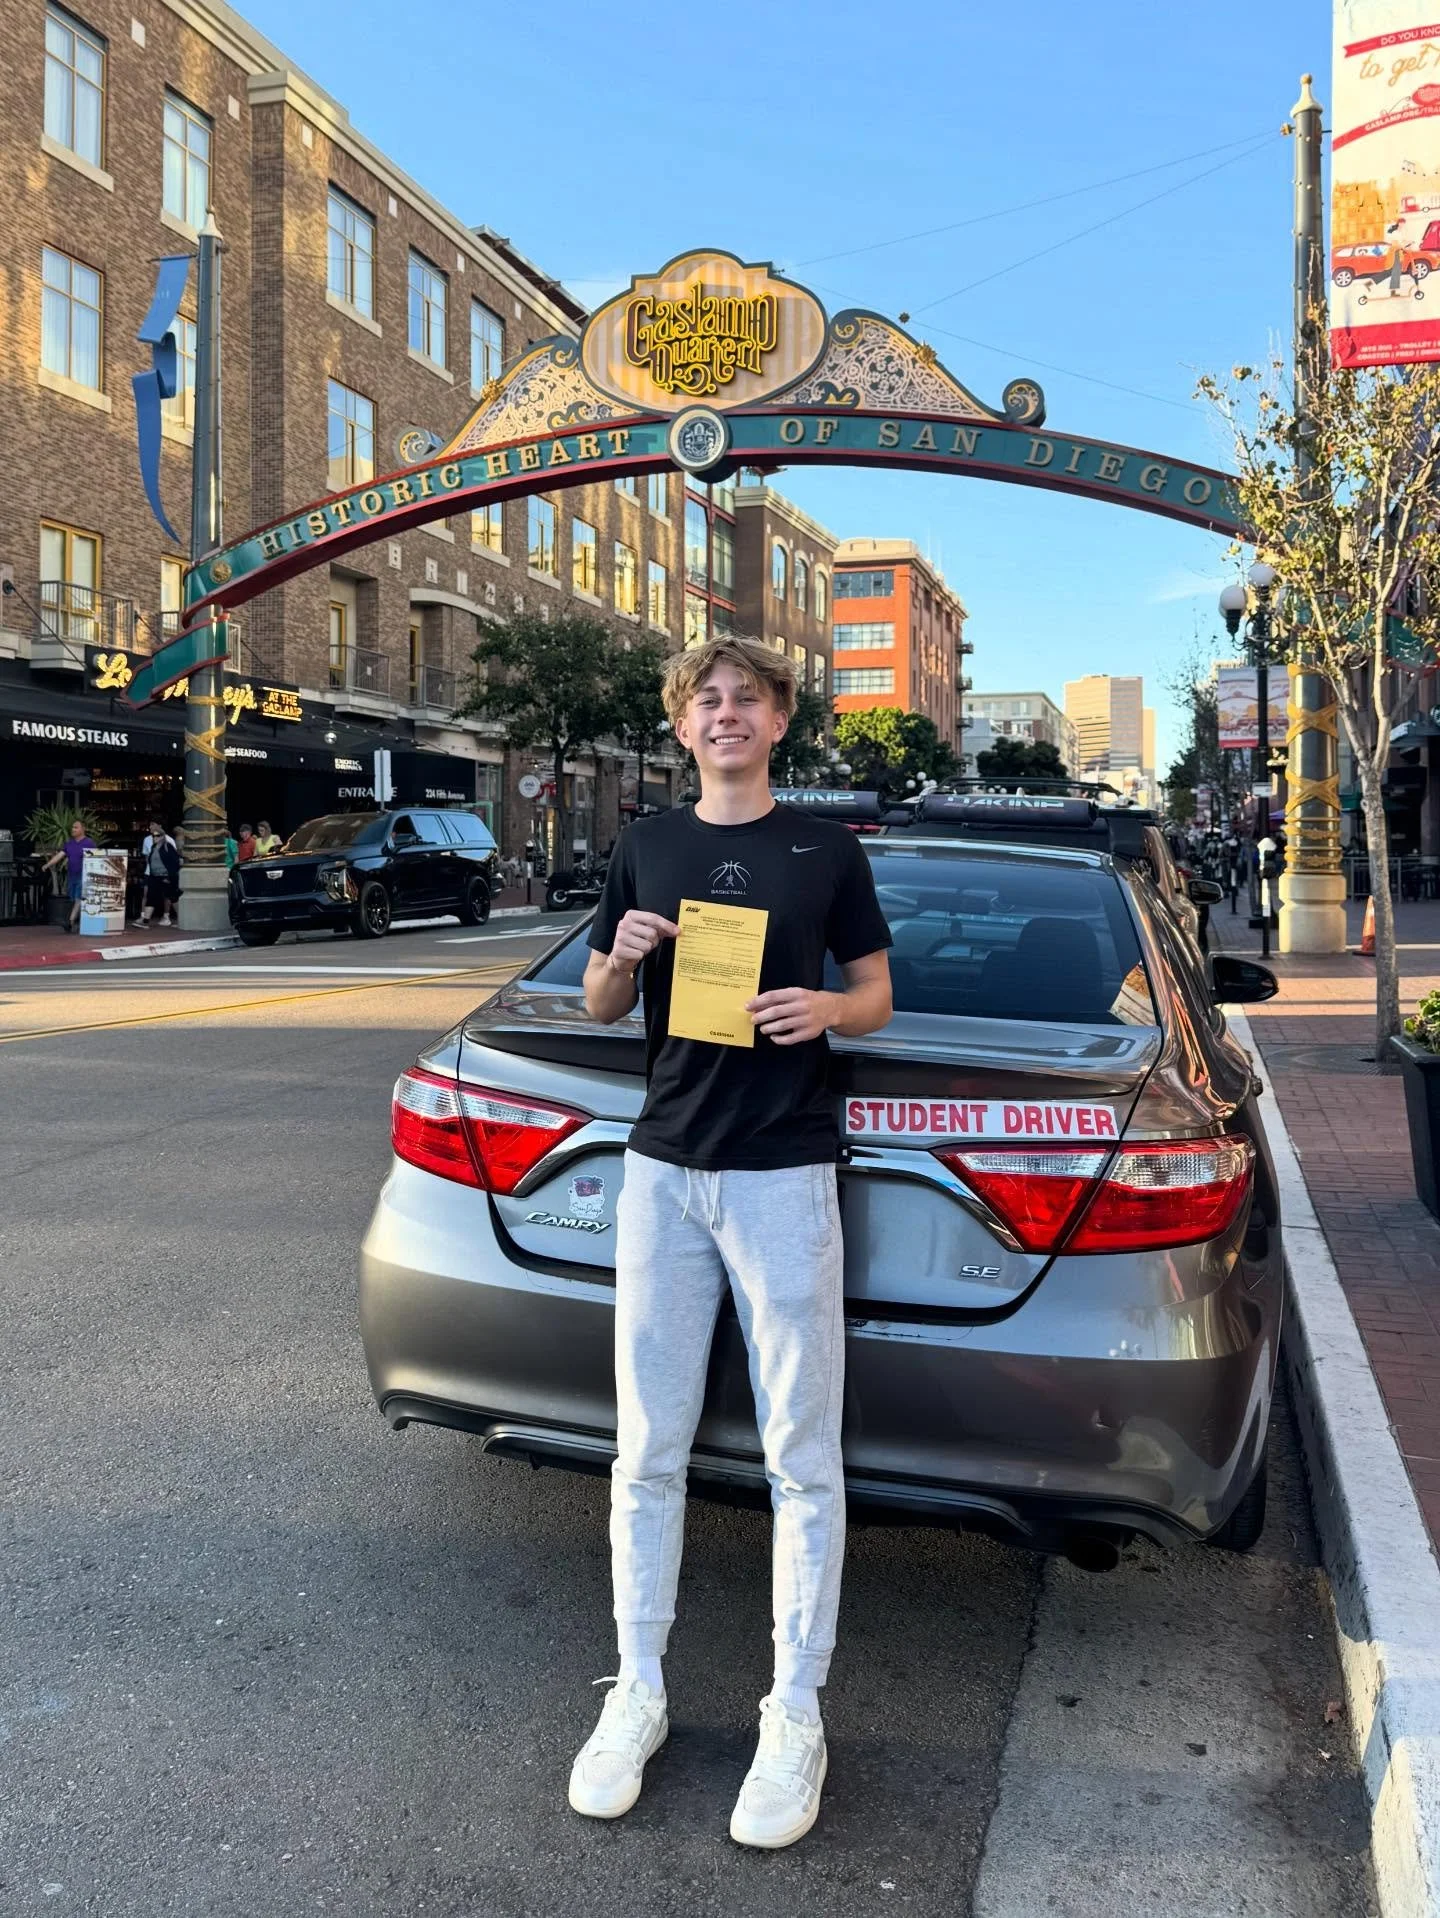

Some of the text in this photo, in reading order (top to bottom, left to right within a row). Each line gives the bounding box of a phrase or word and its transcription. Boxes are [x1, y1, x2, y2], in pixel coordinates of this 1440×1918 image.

[1380, 36, 1397, 46] DO
[1398, 31, 1419, 41] YOU
[1360, 53, 1384, 79] to
[1388, 43, 1429, 87] get
[624, 280, 778, 367] Gaslamp
[650, 335, 763, 396] Quarter
[257, 462, 463, 560] HISTORIC
[483, 428, 630, 479] HEART
[779, 417, 840, 445] OF
[877, 420, 982, 456] SAN
[1024, 438, 1213, 506] DIEGO
[268, 691, 298, 706] AT THE
[262, 702, 303, 718] GASLAMP
[12, 719, 129, 747] FAMOUS STEAKS
[236, 747, 268, 760] SEAFOOD
[338, 786, 398, 798] ENTRAE
[710, 888, 748, 896] BASKETBALL
[847, 1100, 1116, 1136] STUDENT DRIVER
[524, 1211, 611, 1234] CAMRY
[960, 1265, 1001, 1279] SE
